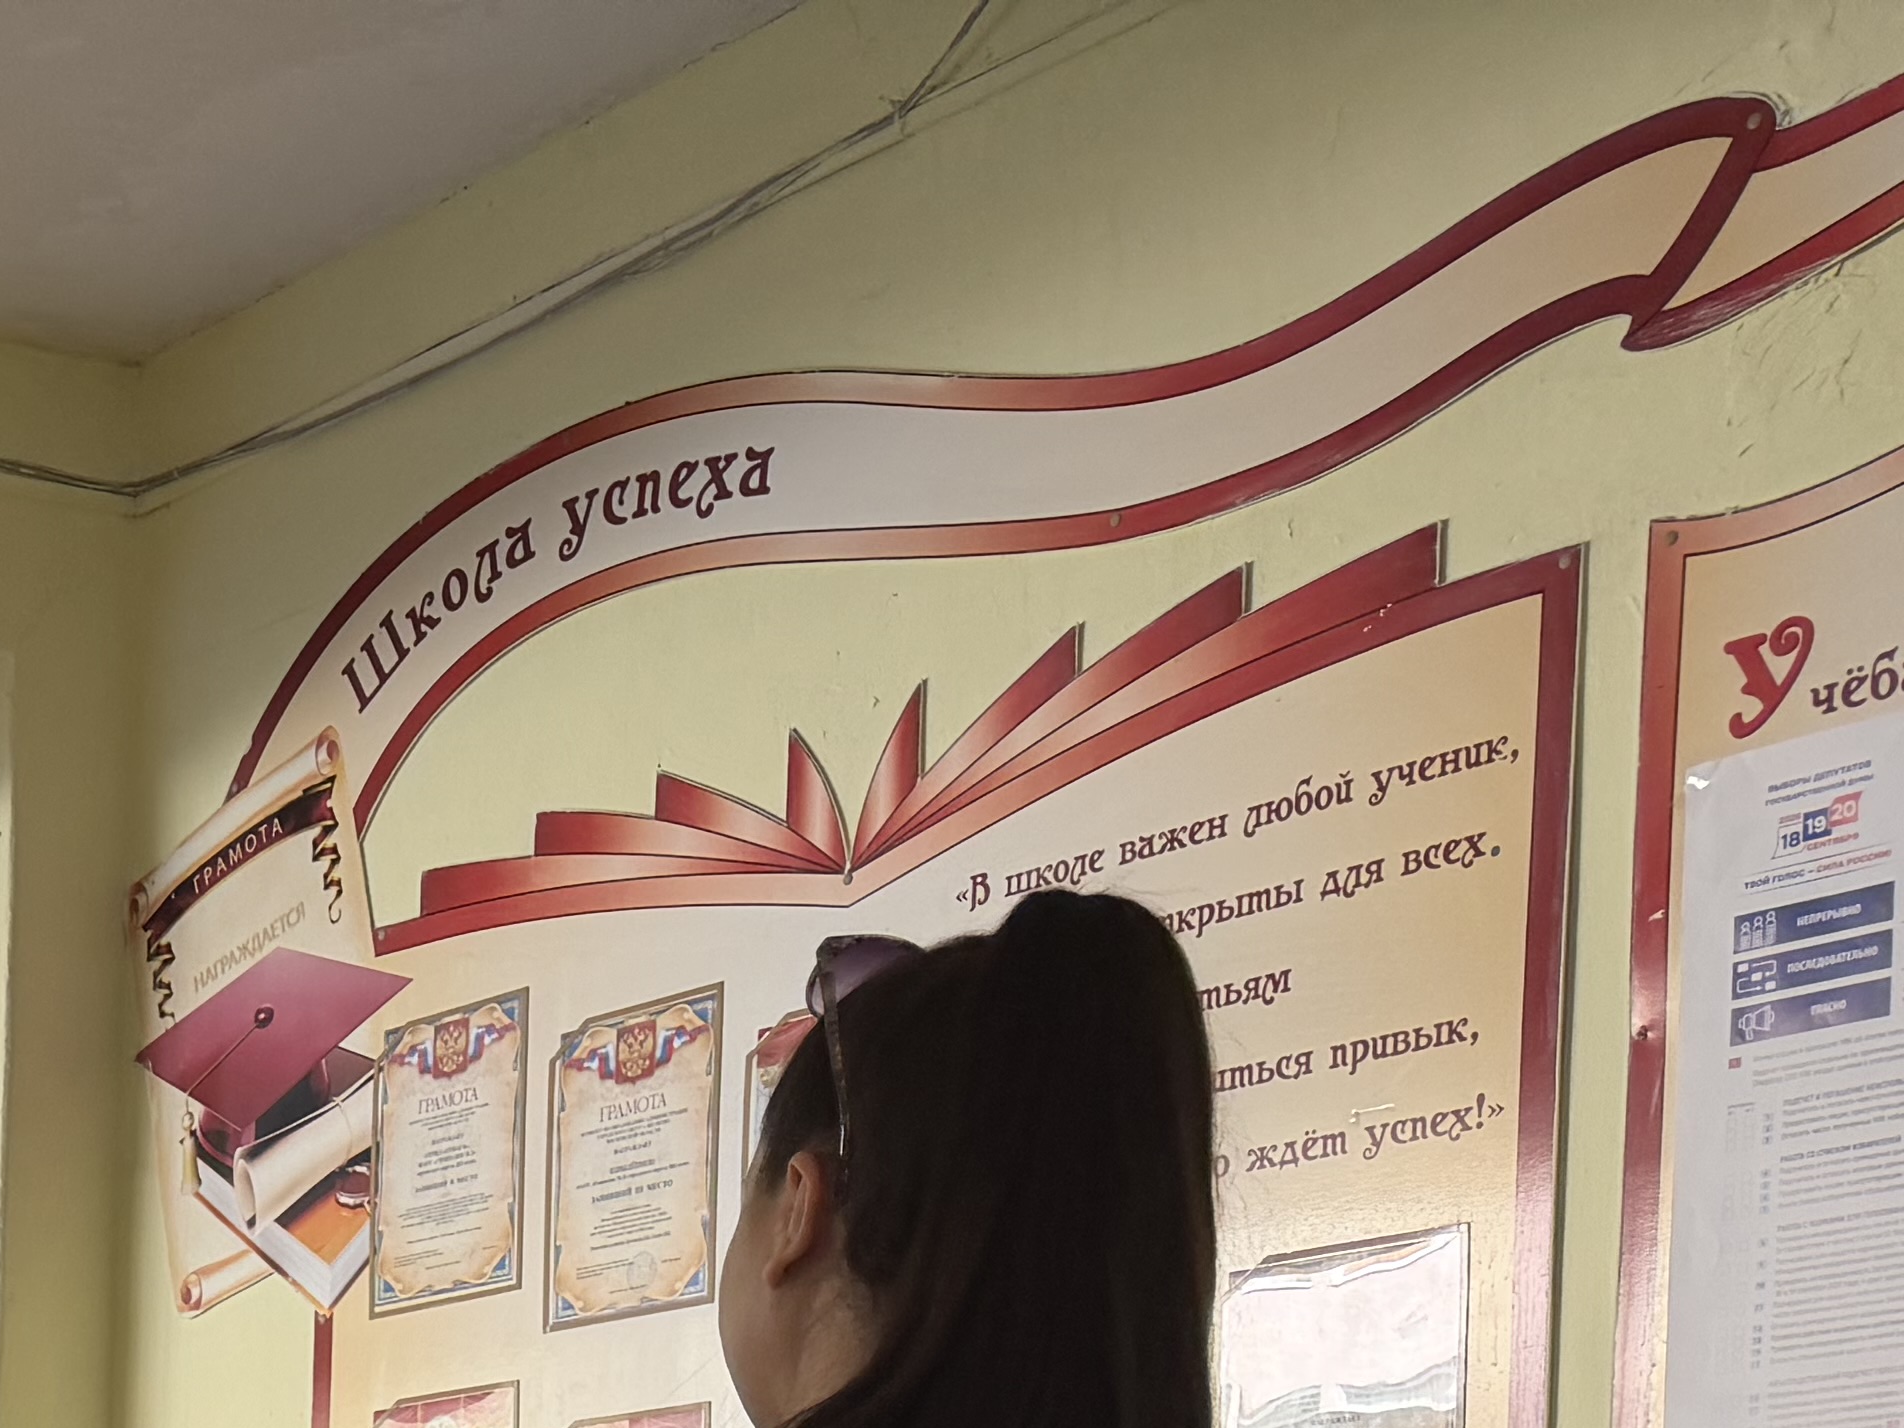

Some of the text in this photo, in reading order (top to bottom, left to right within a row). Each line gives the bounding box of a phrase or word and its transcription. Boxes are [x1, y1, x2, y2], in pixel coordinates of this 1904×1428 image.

[340, 445, 776, 714] Школа успеха
[1723, 615, 1904, 739] Учёб
[192, 817, 284, 894] ГРАМОТА
[956, 735, 1519, 912] «В школе важен любой ученик,
[1780, 831, 1801, 849] 18
[1805, 815, 1827, 835] 19
[1832, 800, 1857, 821] 20
[1320, 858, 1385, 901] для
[1400, 831, 1501, 877] всех.
[194, 900, 307, 993] НАГРАЖДАЕТСЯ
[1328, 1017, 1479, 1075] привык,
[418, 1086, 479, 1115] ГРАМОТА
[600, 1092, 667, 1122] ГРАМОТА
[1245, 1129, 1348, 1172] ждёт
[1362, 1093, 1505, 1160] успех!»
